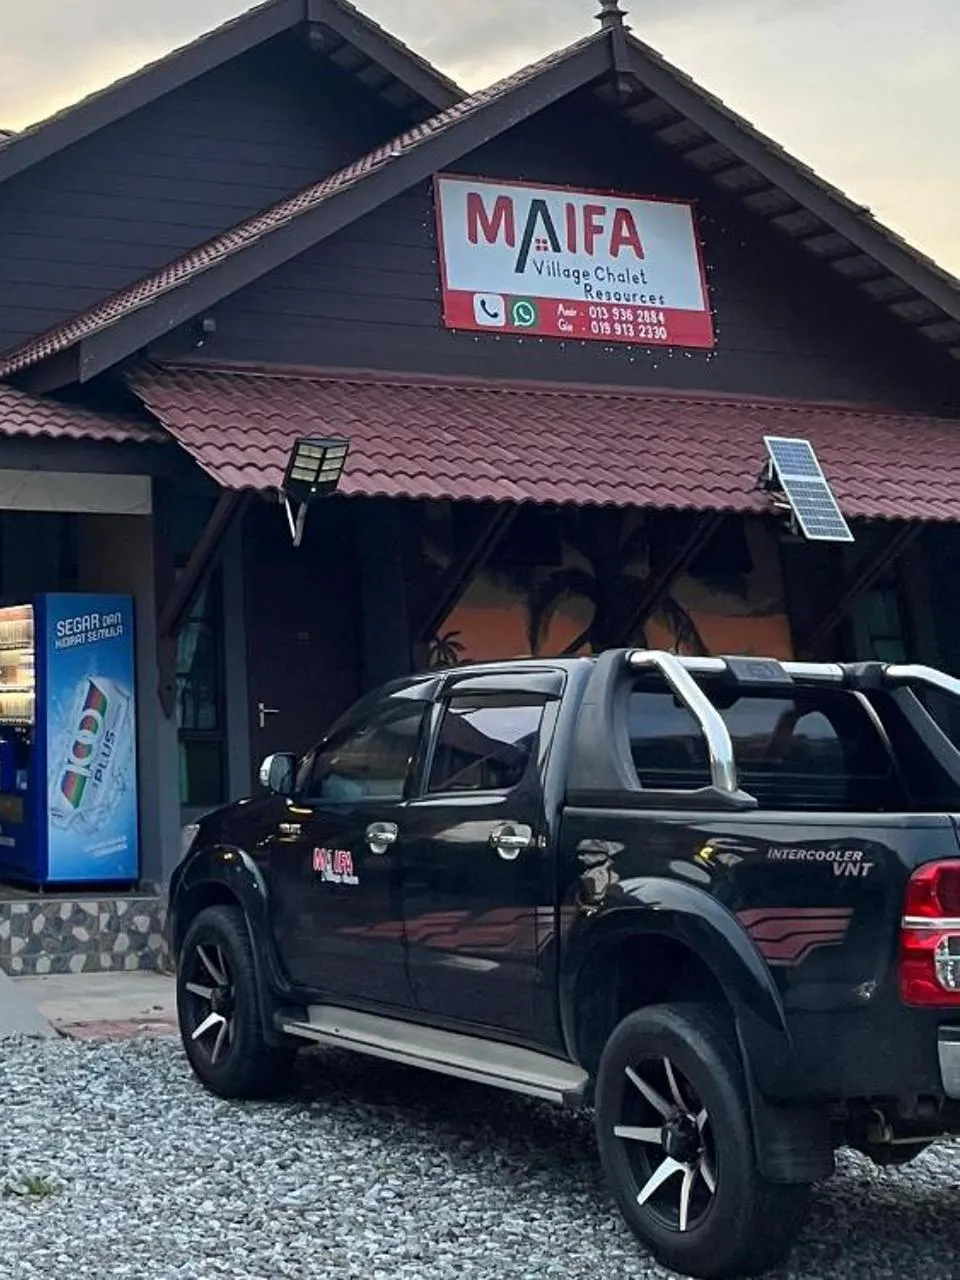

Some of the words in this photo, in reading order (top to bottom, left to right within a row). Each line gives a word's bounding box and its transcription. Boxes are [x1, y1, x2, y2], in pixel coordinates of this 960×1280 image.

[466, 192, 645, 273] MAIFA
[532, 259, 590, 285] Village
[594, 265, 647, 284] Chalet
[584, 282, 664, 305] Resources
[589, 306, 609, 319] 013
[612, 307, 633, 321] 936
[613, 322, 634, 337] 913
[638, 324, 667, 339] 2330
[56, 613, 99, 636] SEGAR
[766, 847, 863, 861] INTERCOOLER
[832, 862, 874, 876] VNT
